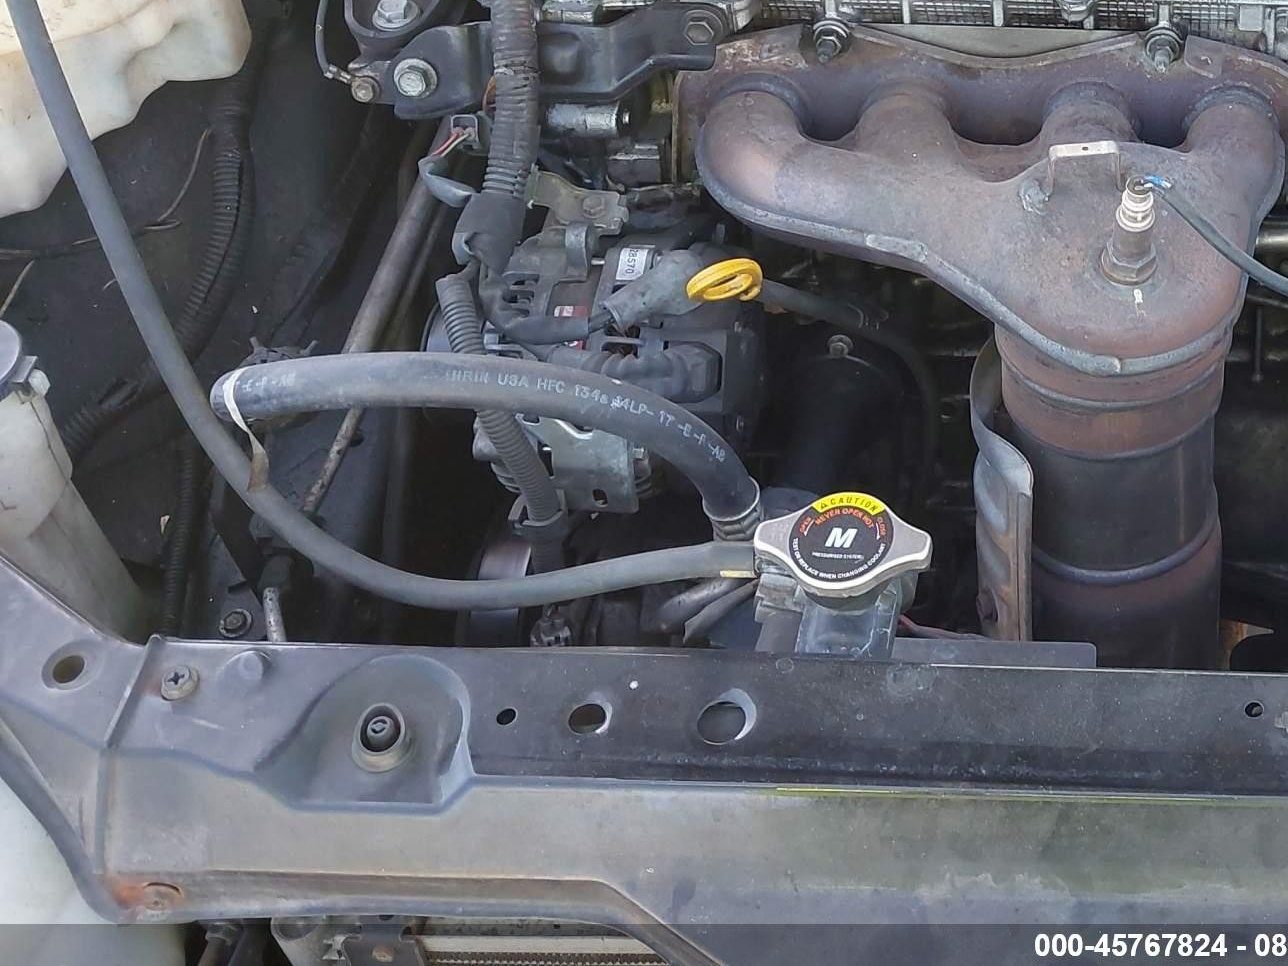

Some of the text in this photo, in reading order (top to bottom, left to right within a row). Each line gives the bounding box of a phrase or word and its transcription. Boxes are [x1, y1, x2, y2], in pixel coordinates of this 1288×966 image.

[830, 496, 879, 512] CAUTION
[815, 507, 875, 529] NEVER OPEN HOT
[825, 527, 858, 548] M
